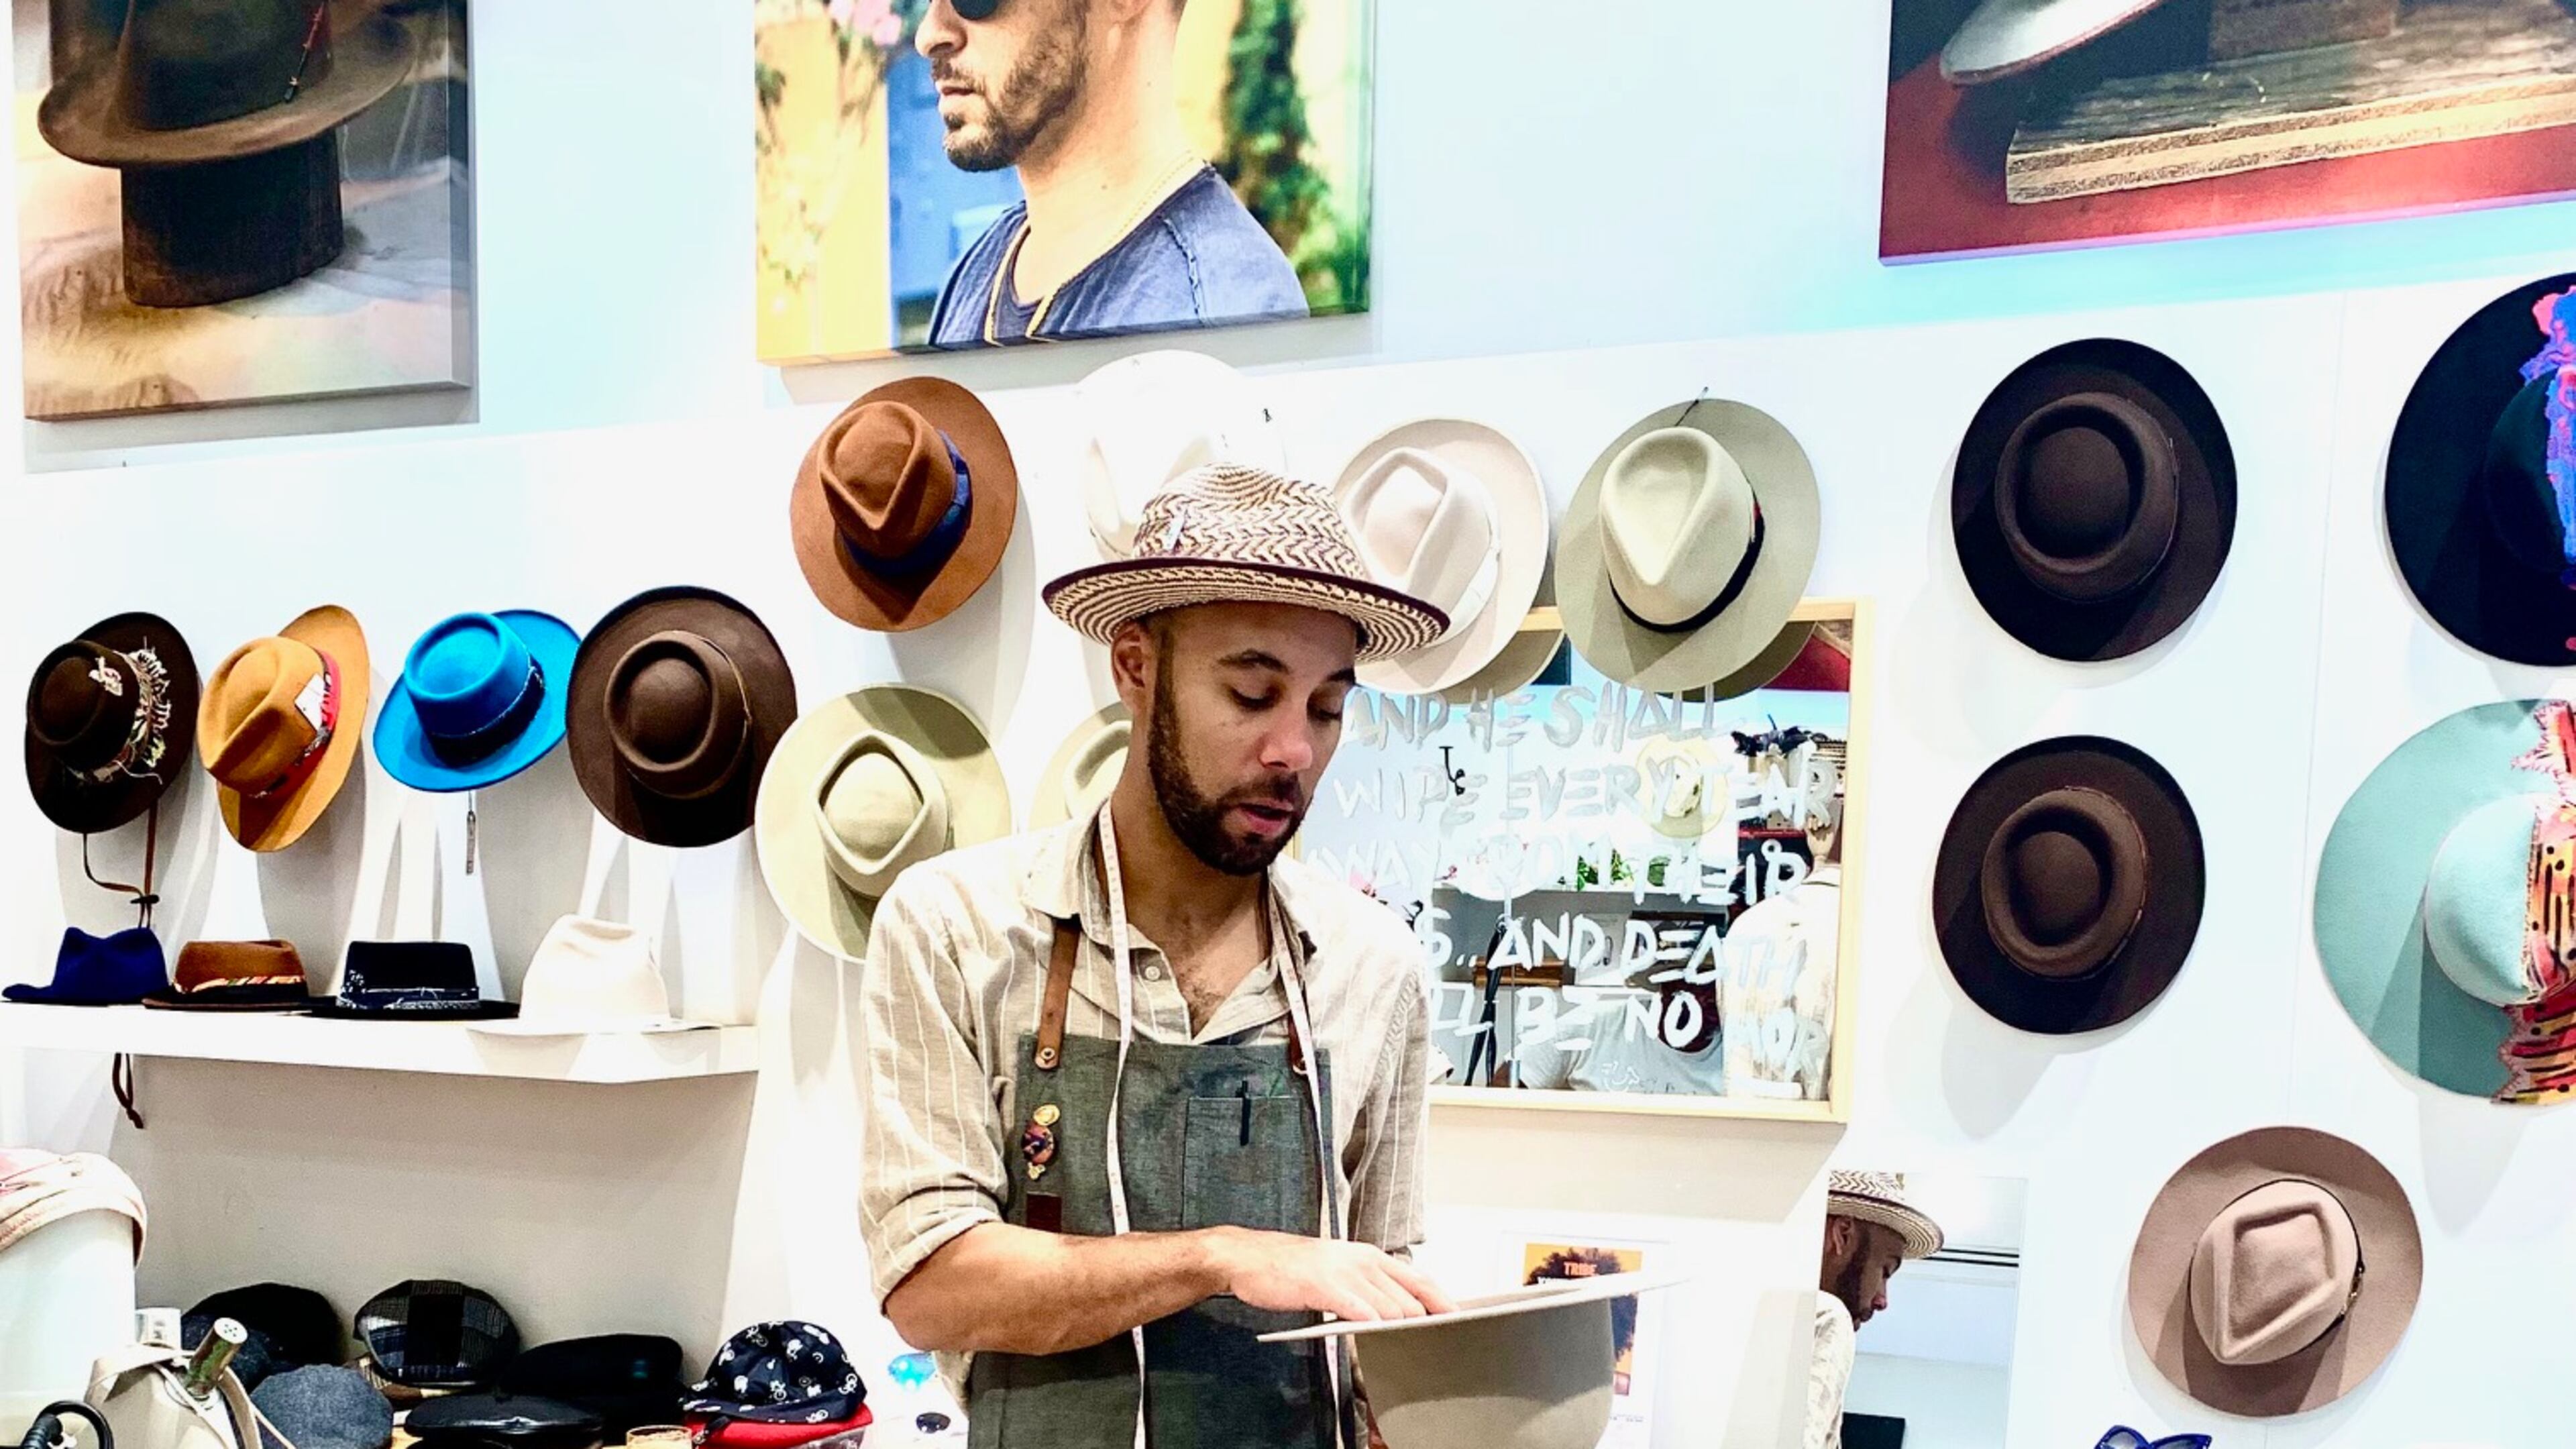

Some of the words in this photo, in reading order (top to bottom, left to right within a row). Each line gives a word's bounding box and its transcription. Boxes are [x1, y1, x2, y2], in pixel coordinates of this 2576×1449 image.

[1344, 688, 1451, 751] AND
[1464, 687, 1537, 753] HE
[1543, 681, 1746, 753] SHALL
[1333, 765, 1489, 829] WIPE
[1499, 756, 1676, 824] EVERY
[1486, 911, 1606, 972] AND
[1620, 919, 1808, 1000] DEATH
[1623, 989, 1703, 1049] NO
